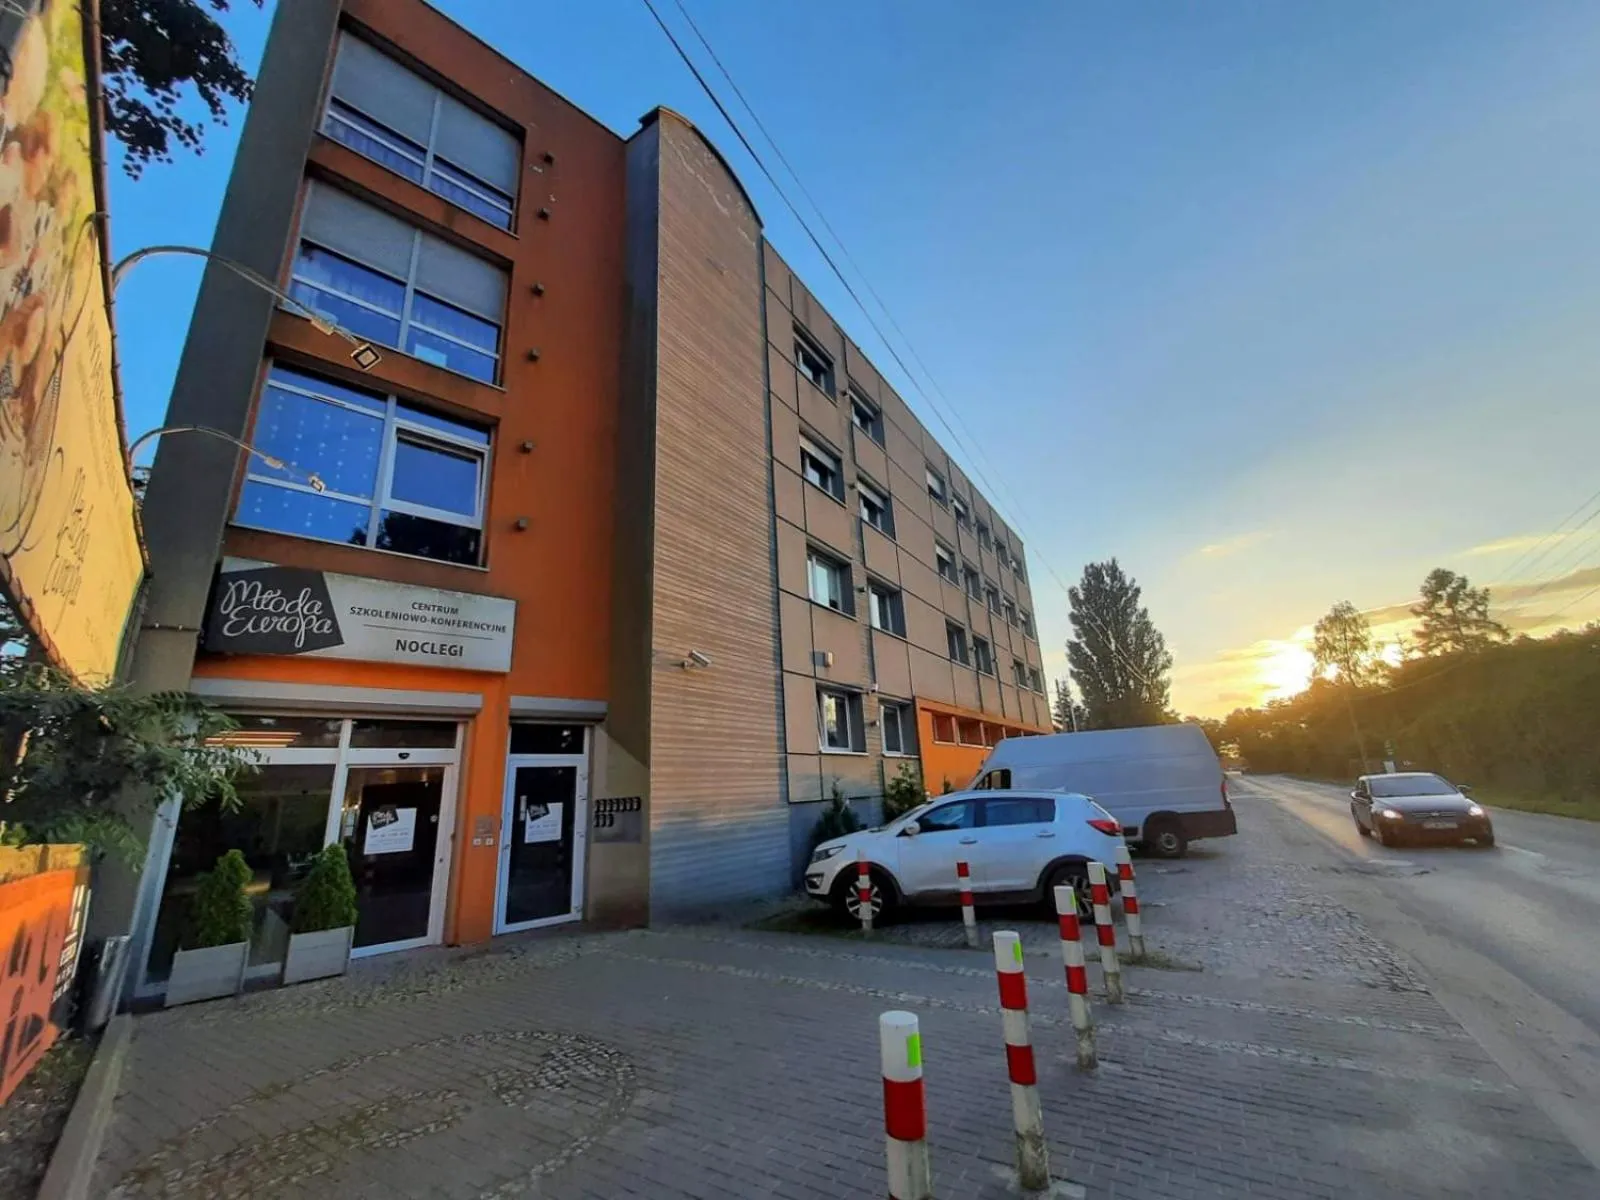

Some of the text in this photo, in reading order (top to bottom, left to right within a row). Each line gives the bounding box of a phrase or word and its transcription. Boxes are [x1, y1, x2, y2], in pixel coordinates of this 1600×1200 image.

[221, 580, 323, 614] Młoda
[411, 601, 459, 615] CENTRUM
[223, 606, 332, 648] Europa
[350, 606, 507, 633] SZKOLENIOWO-KONFERENCYJNE
[395, 639, 464, 657] NOCLEGI
